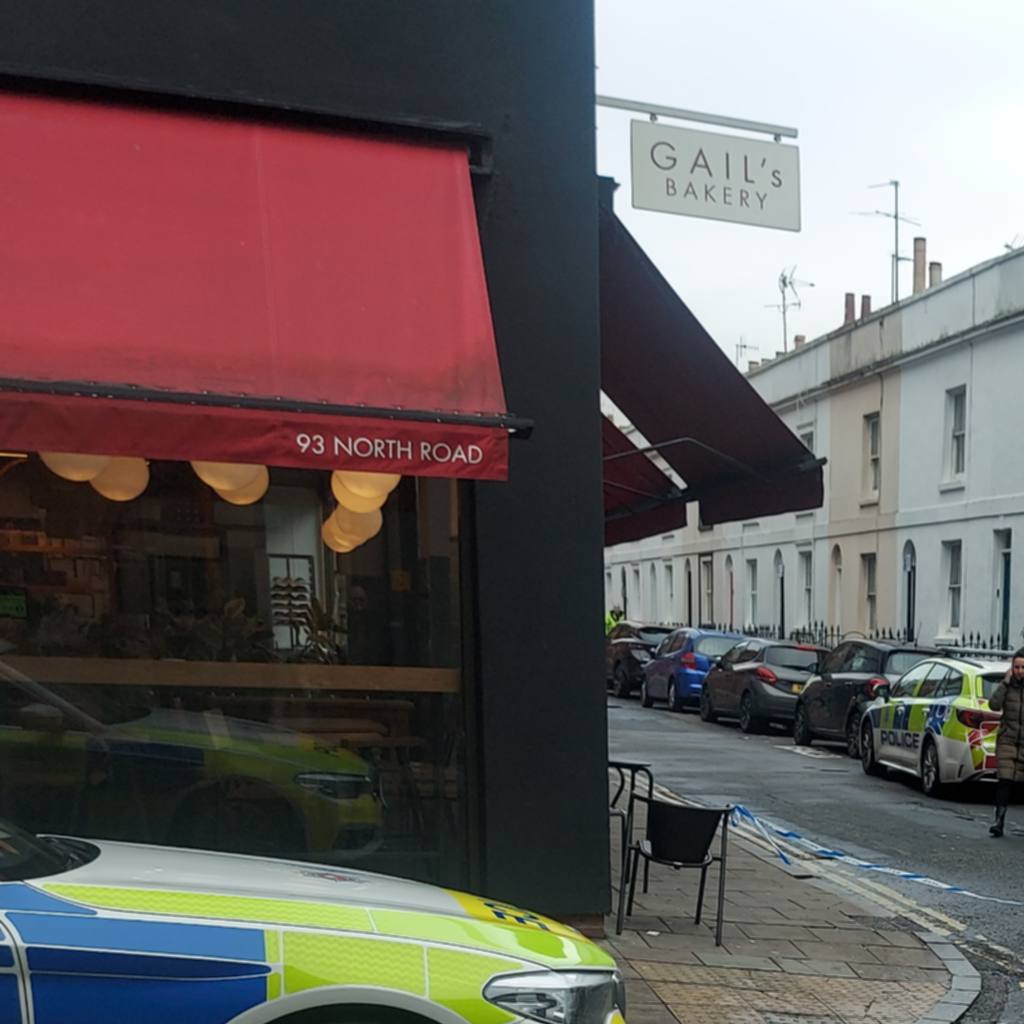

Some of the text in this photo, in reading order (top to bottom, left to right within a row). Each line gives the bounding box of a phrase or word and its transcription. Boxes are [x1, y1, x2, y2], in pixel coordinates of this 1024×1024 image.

[666, 178, 768, 210] BAKERY
[296, 433, 484, 464] 93 NORTH ROAD
[880, 730, 920, 749] POLICE
